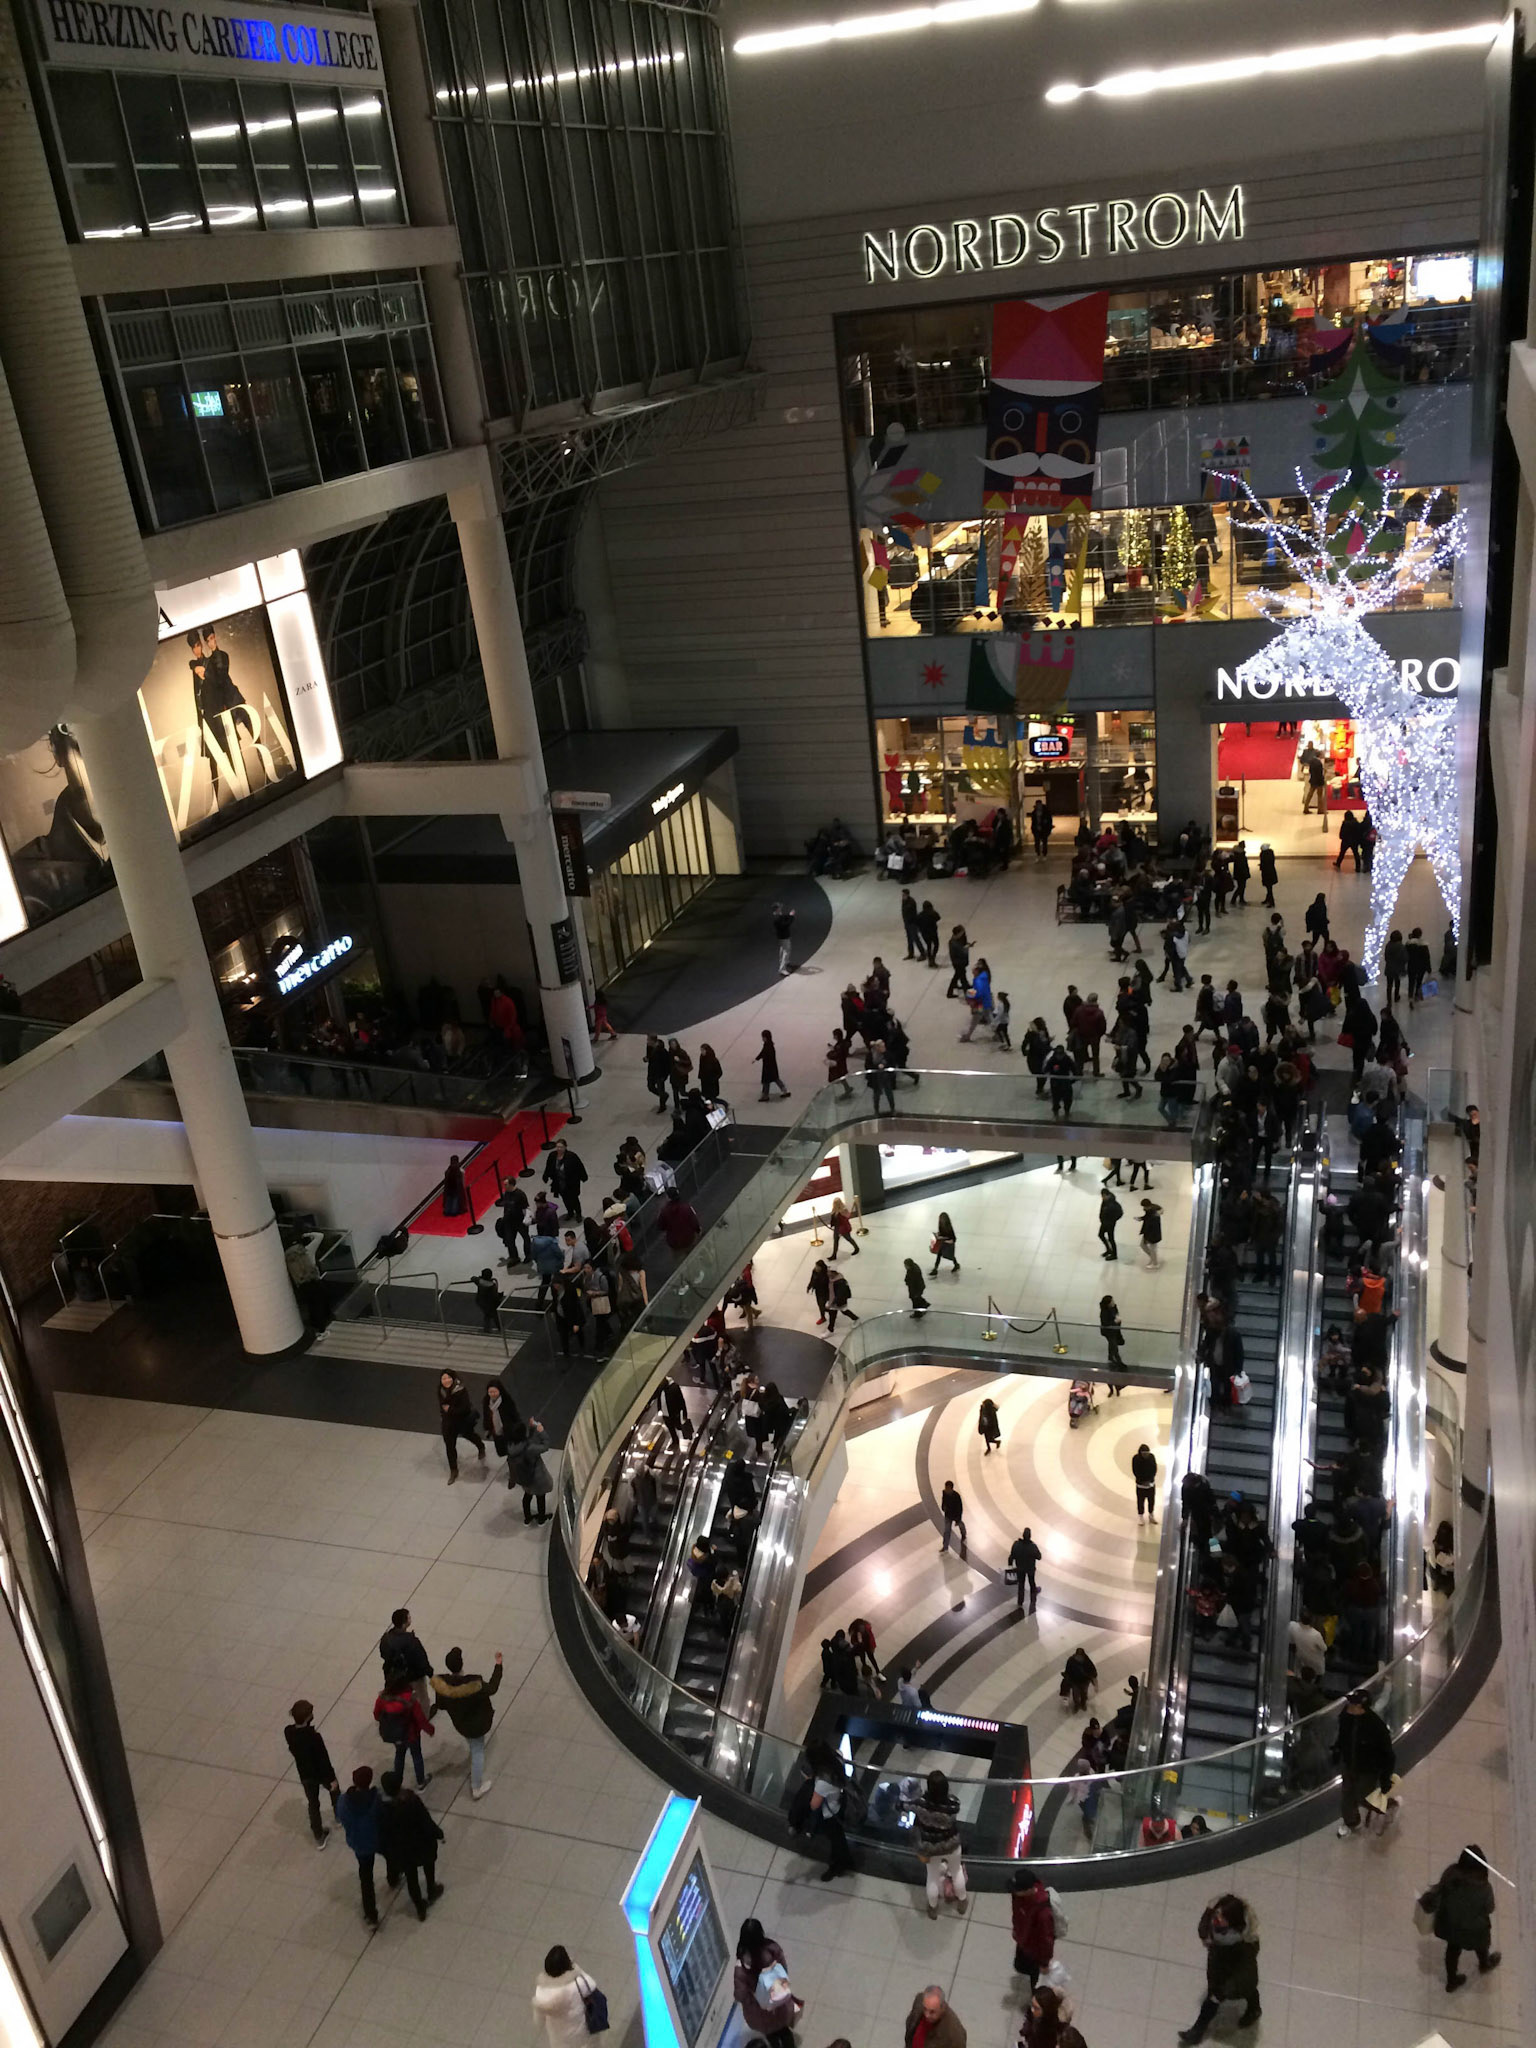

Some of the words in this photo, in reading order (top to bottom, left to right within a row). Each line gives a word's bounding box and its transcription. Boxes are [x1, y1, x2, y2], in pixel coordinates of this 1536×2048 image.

[50, 0, 179, 52] HERZING
[182, 12, 281, 62] CAREER
[281, 23, 378, 71] COLLEGE
[863, 184, 1244, 284] NORDSTROM
[295, 681, 318, 696] ZARA
[155, 691, 298, 832] ZARA
[561, 835, 576, 890] mercatto
